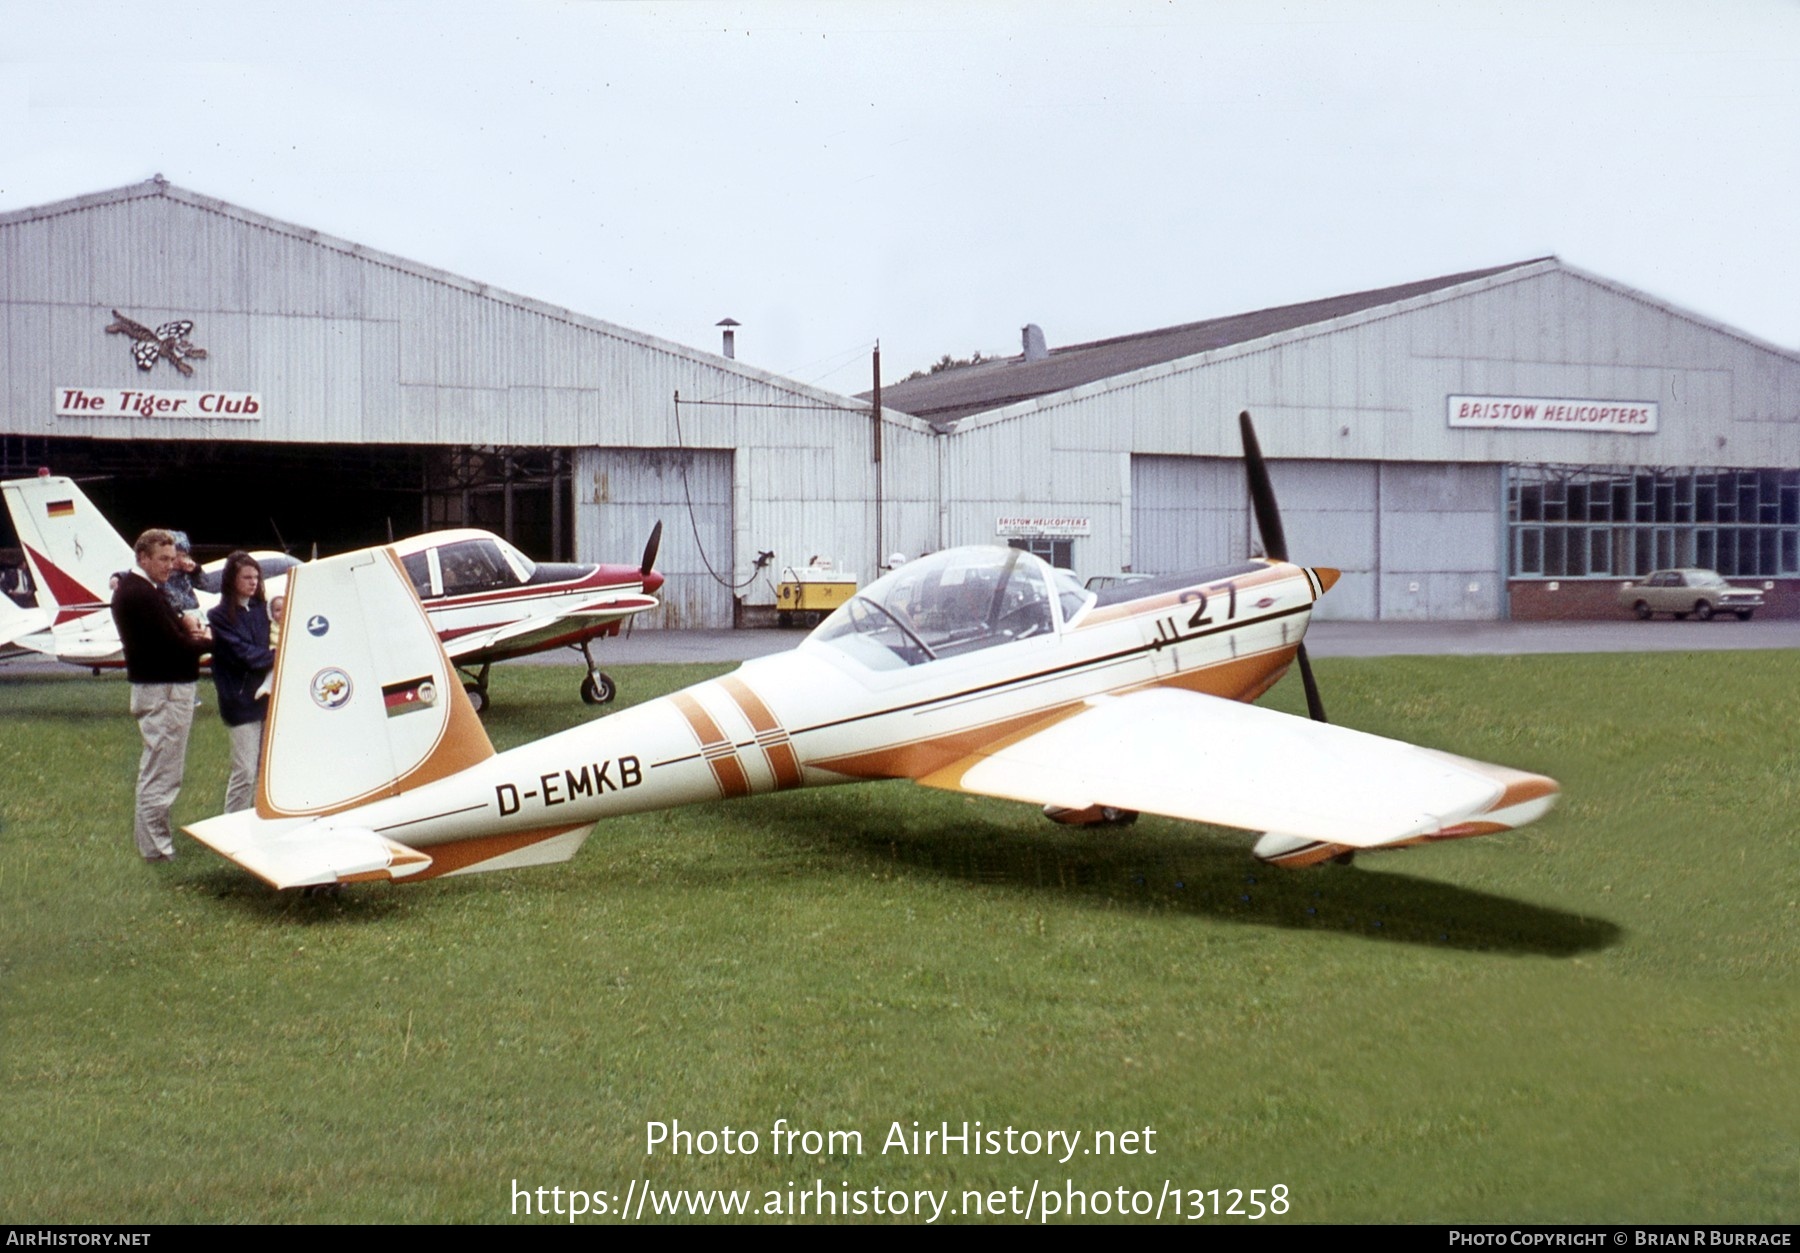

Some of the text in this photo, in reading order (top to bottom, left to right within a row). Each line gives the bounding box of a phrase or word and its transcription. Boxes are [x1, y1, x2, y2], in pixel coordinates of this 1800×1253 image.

[63, 390, 259, 417] The Tiger Club
[1459, 402, 1648, 424] BRISTOW HELICOPTERS
[999, 517, 1088, 526] BRISTOW HELICOPTERS
[1180, 581, 1236, 629] 27
[495, 755, 642, 816] D-EMKB
